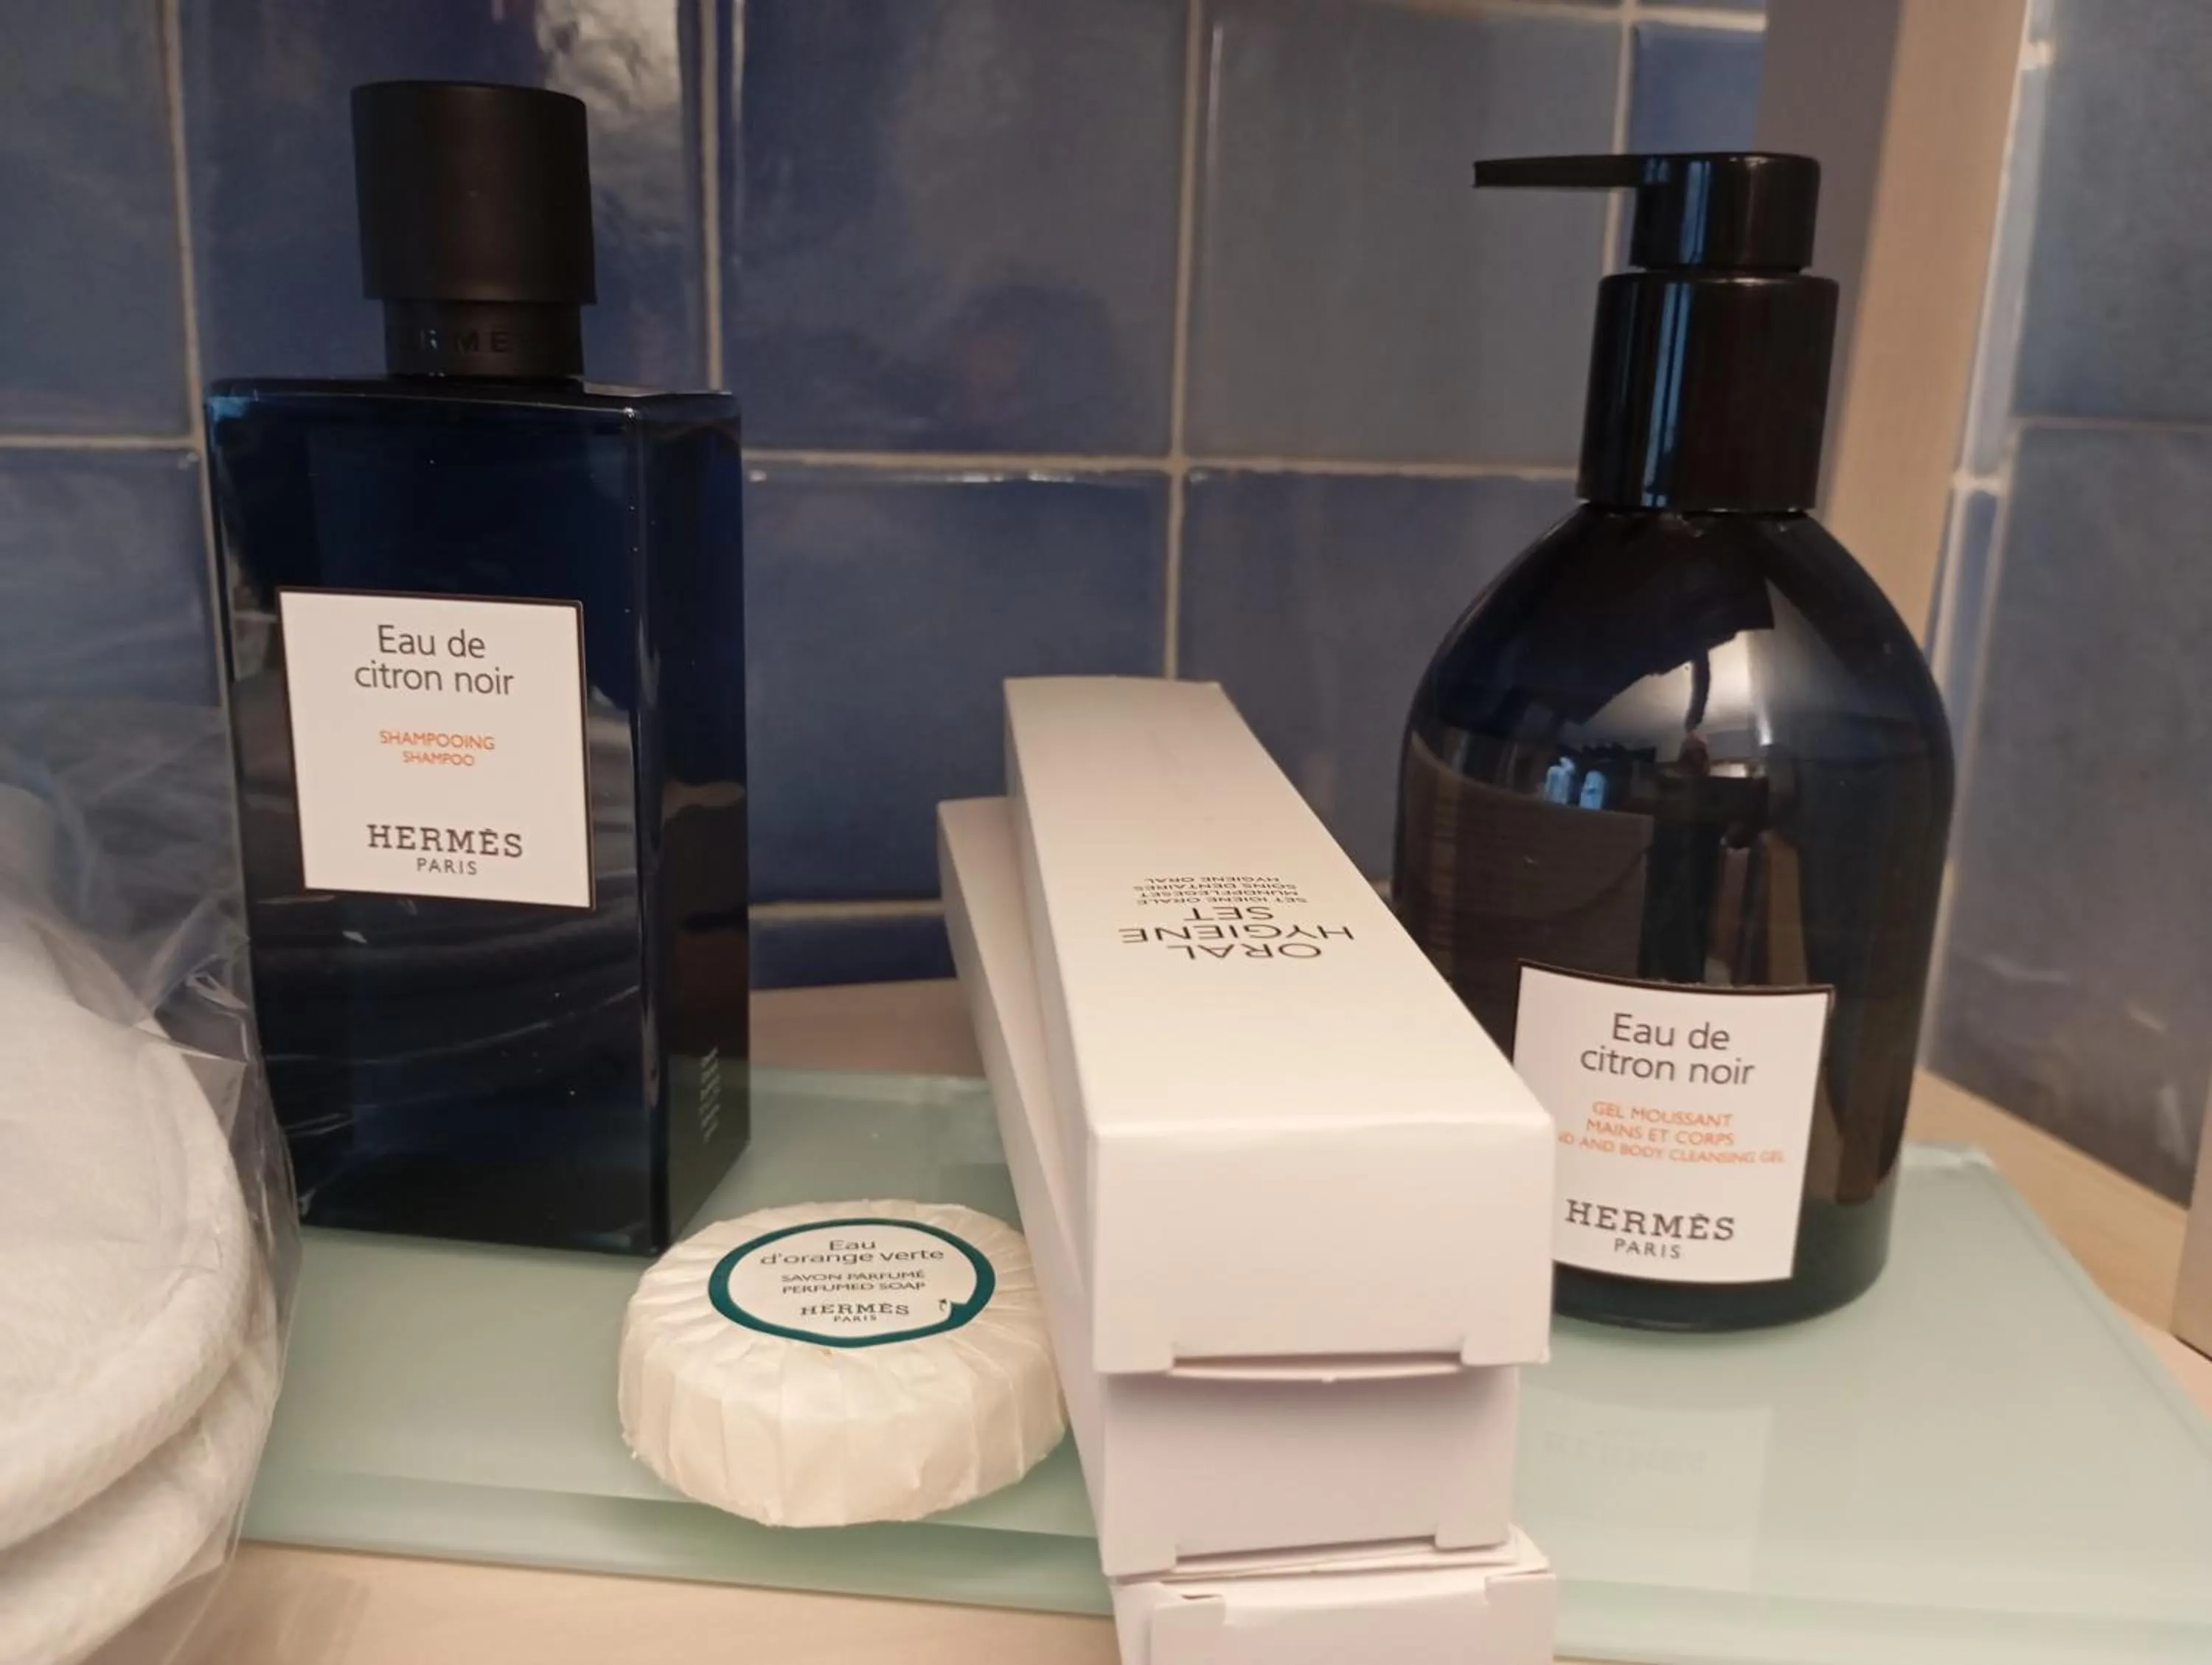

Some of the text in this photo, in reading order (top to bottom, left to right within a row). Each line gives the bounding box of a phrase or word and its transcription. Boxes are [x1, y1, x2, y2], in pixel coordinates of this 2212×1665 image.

[378, 625, 486, 658] Eau de
[355, 661, 515, 695] citron noir
[380, 730, 495, 750] SHAMPOOING
[403, 751, 475, 766] SHAMPOO
[366, 824, 523, 858] HERMÈS
[417, 858, 478, 875] PARIS
[1136, 897, 1201, 906] ORALE
[1184, 906, 1274, 921] SET
[1119, 925, 1354, 942] HYGIENE
[1167, 943, 1321, 959] ORAL
[1613, 1012, 1731, 1051] Eau de
[1580, 1046, 1756, 1085] citron noir
[1592, 1101, 1733, 1127] GEL MOUSSANT
[1586, 1118, 1734, 1146] MAINS ET CORPS
[1580, 1136, 1614, 1153] AND
[1620, 1142, 1663, 1160] BODY
[1669, 1148, 1756, 1164] CLEANSING
[1759, 1150, 1785, 1164] GEL
[829, 1240, 876, 1251] Eau
[1613, 1237, 1681, 1259] PARIS
[759, 1248, 945, 1265] d'orange verte
[781, 1273, 842, 1282] SAVON
[782, 1280, 926, 1294] PERFUMED SOAP
[834, 1314, 877, 1322] PARIS
